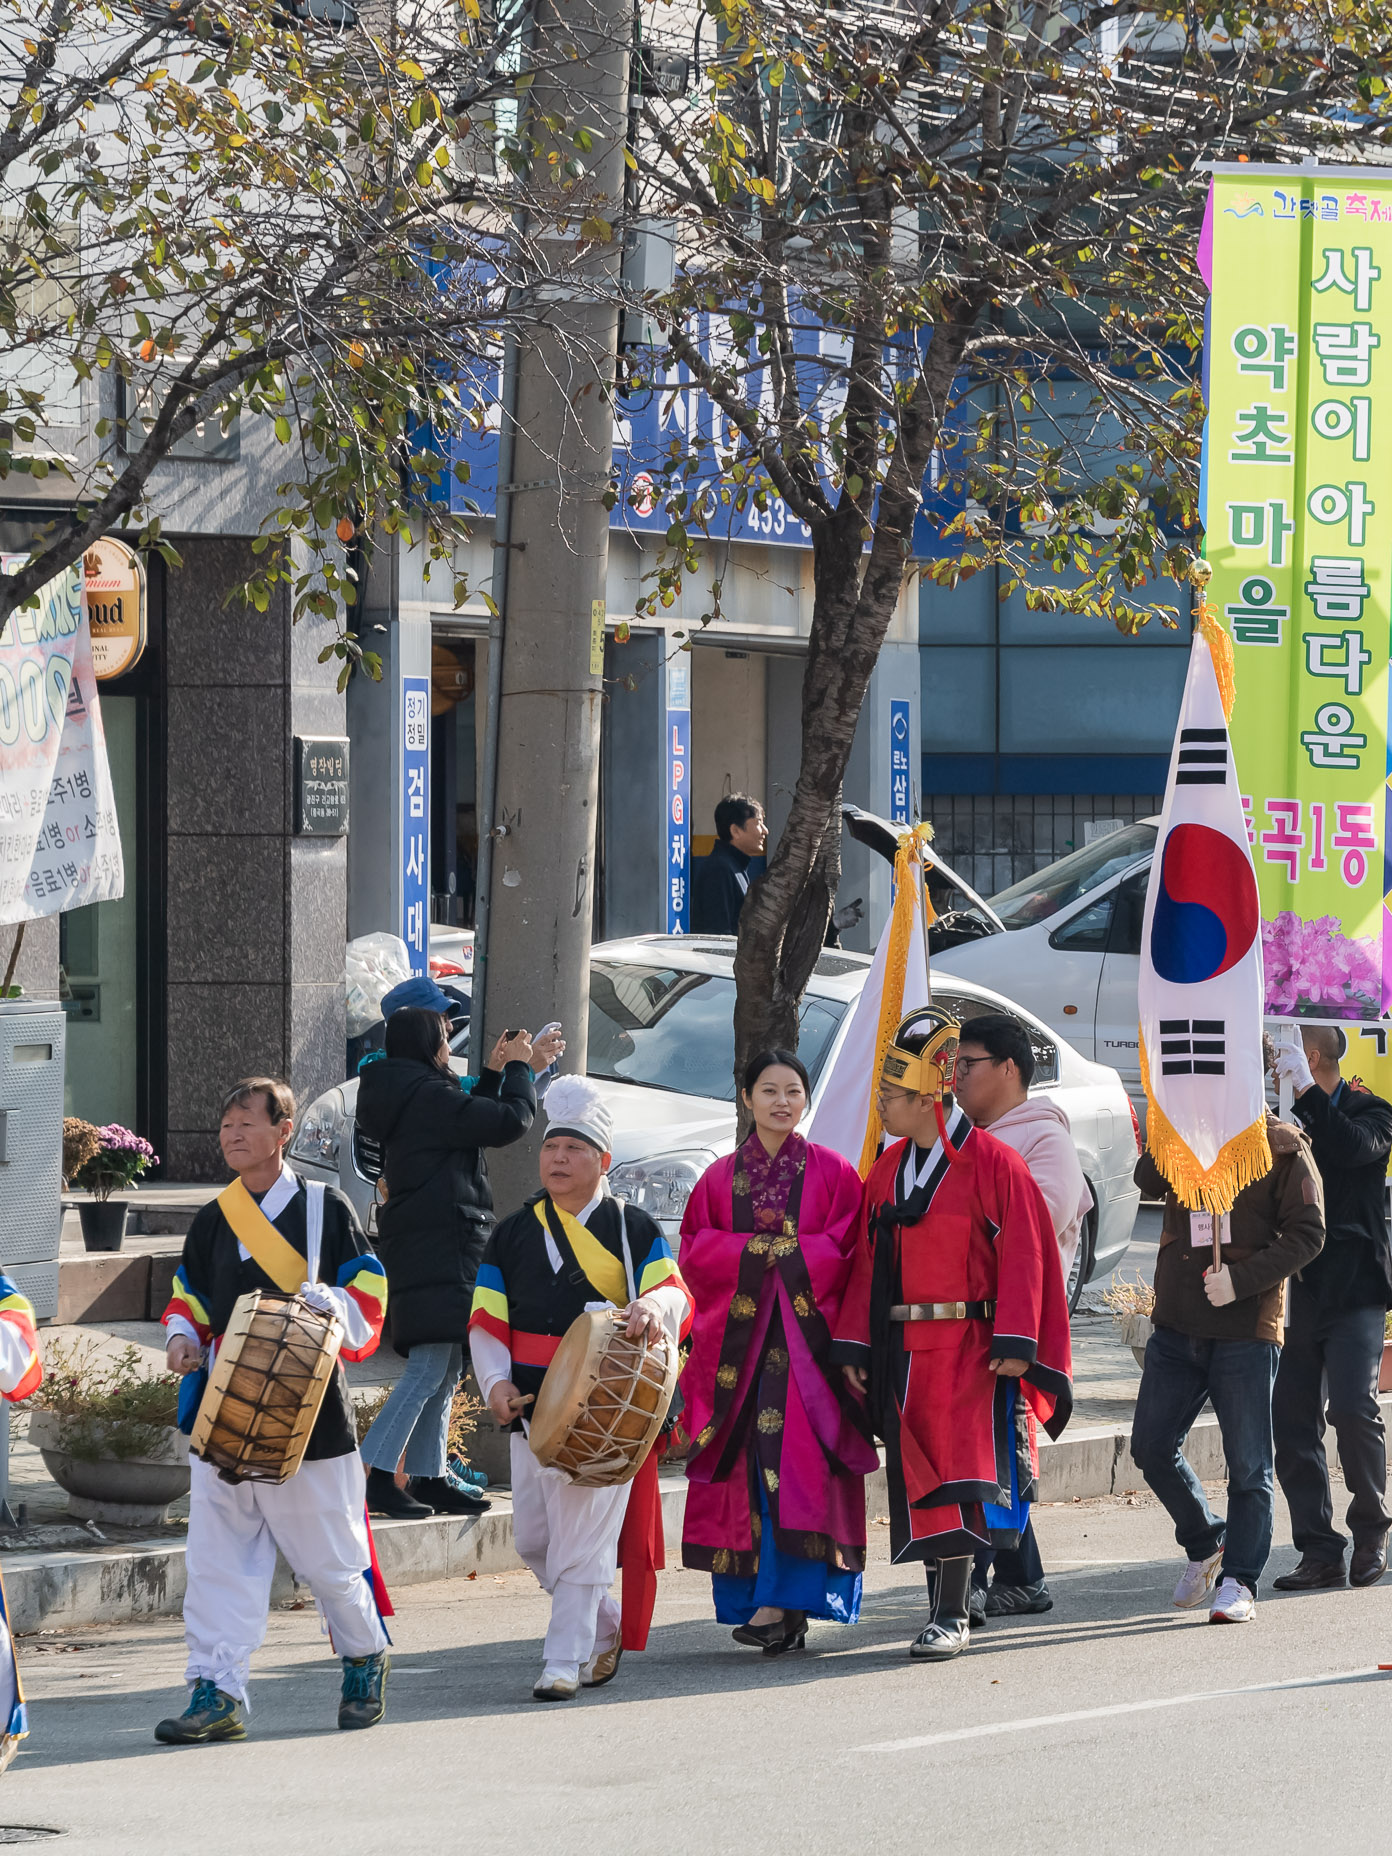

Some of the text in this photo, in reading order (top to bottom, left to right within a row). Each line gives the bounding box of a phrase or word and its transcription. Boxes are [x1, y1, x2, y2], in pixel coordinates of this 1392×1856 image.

[747, 498, 812, 537] 453-
[406, 697, 425, 720] 정기
[406, 723, 425, 745] 정밀
[406, 765, 425, 977] 검사대
